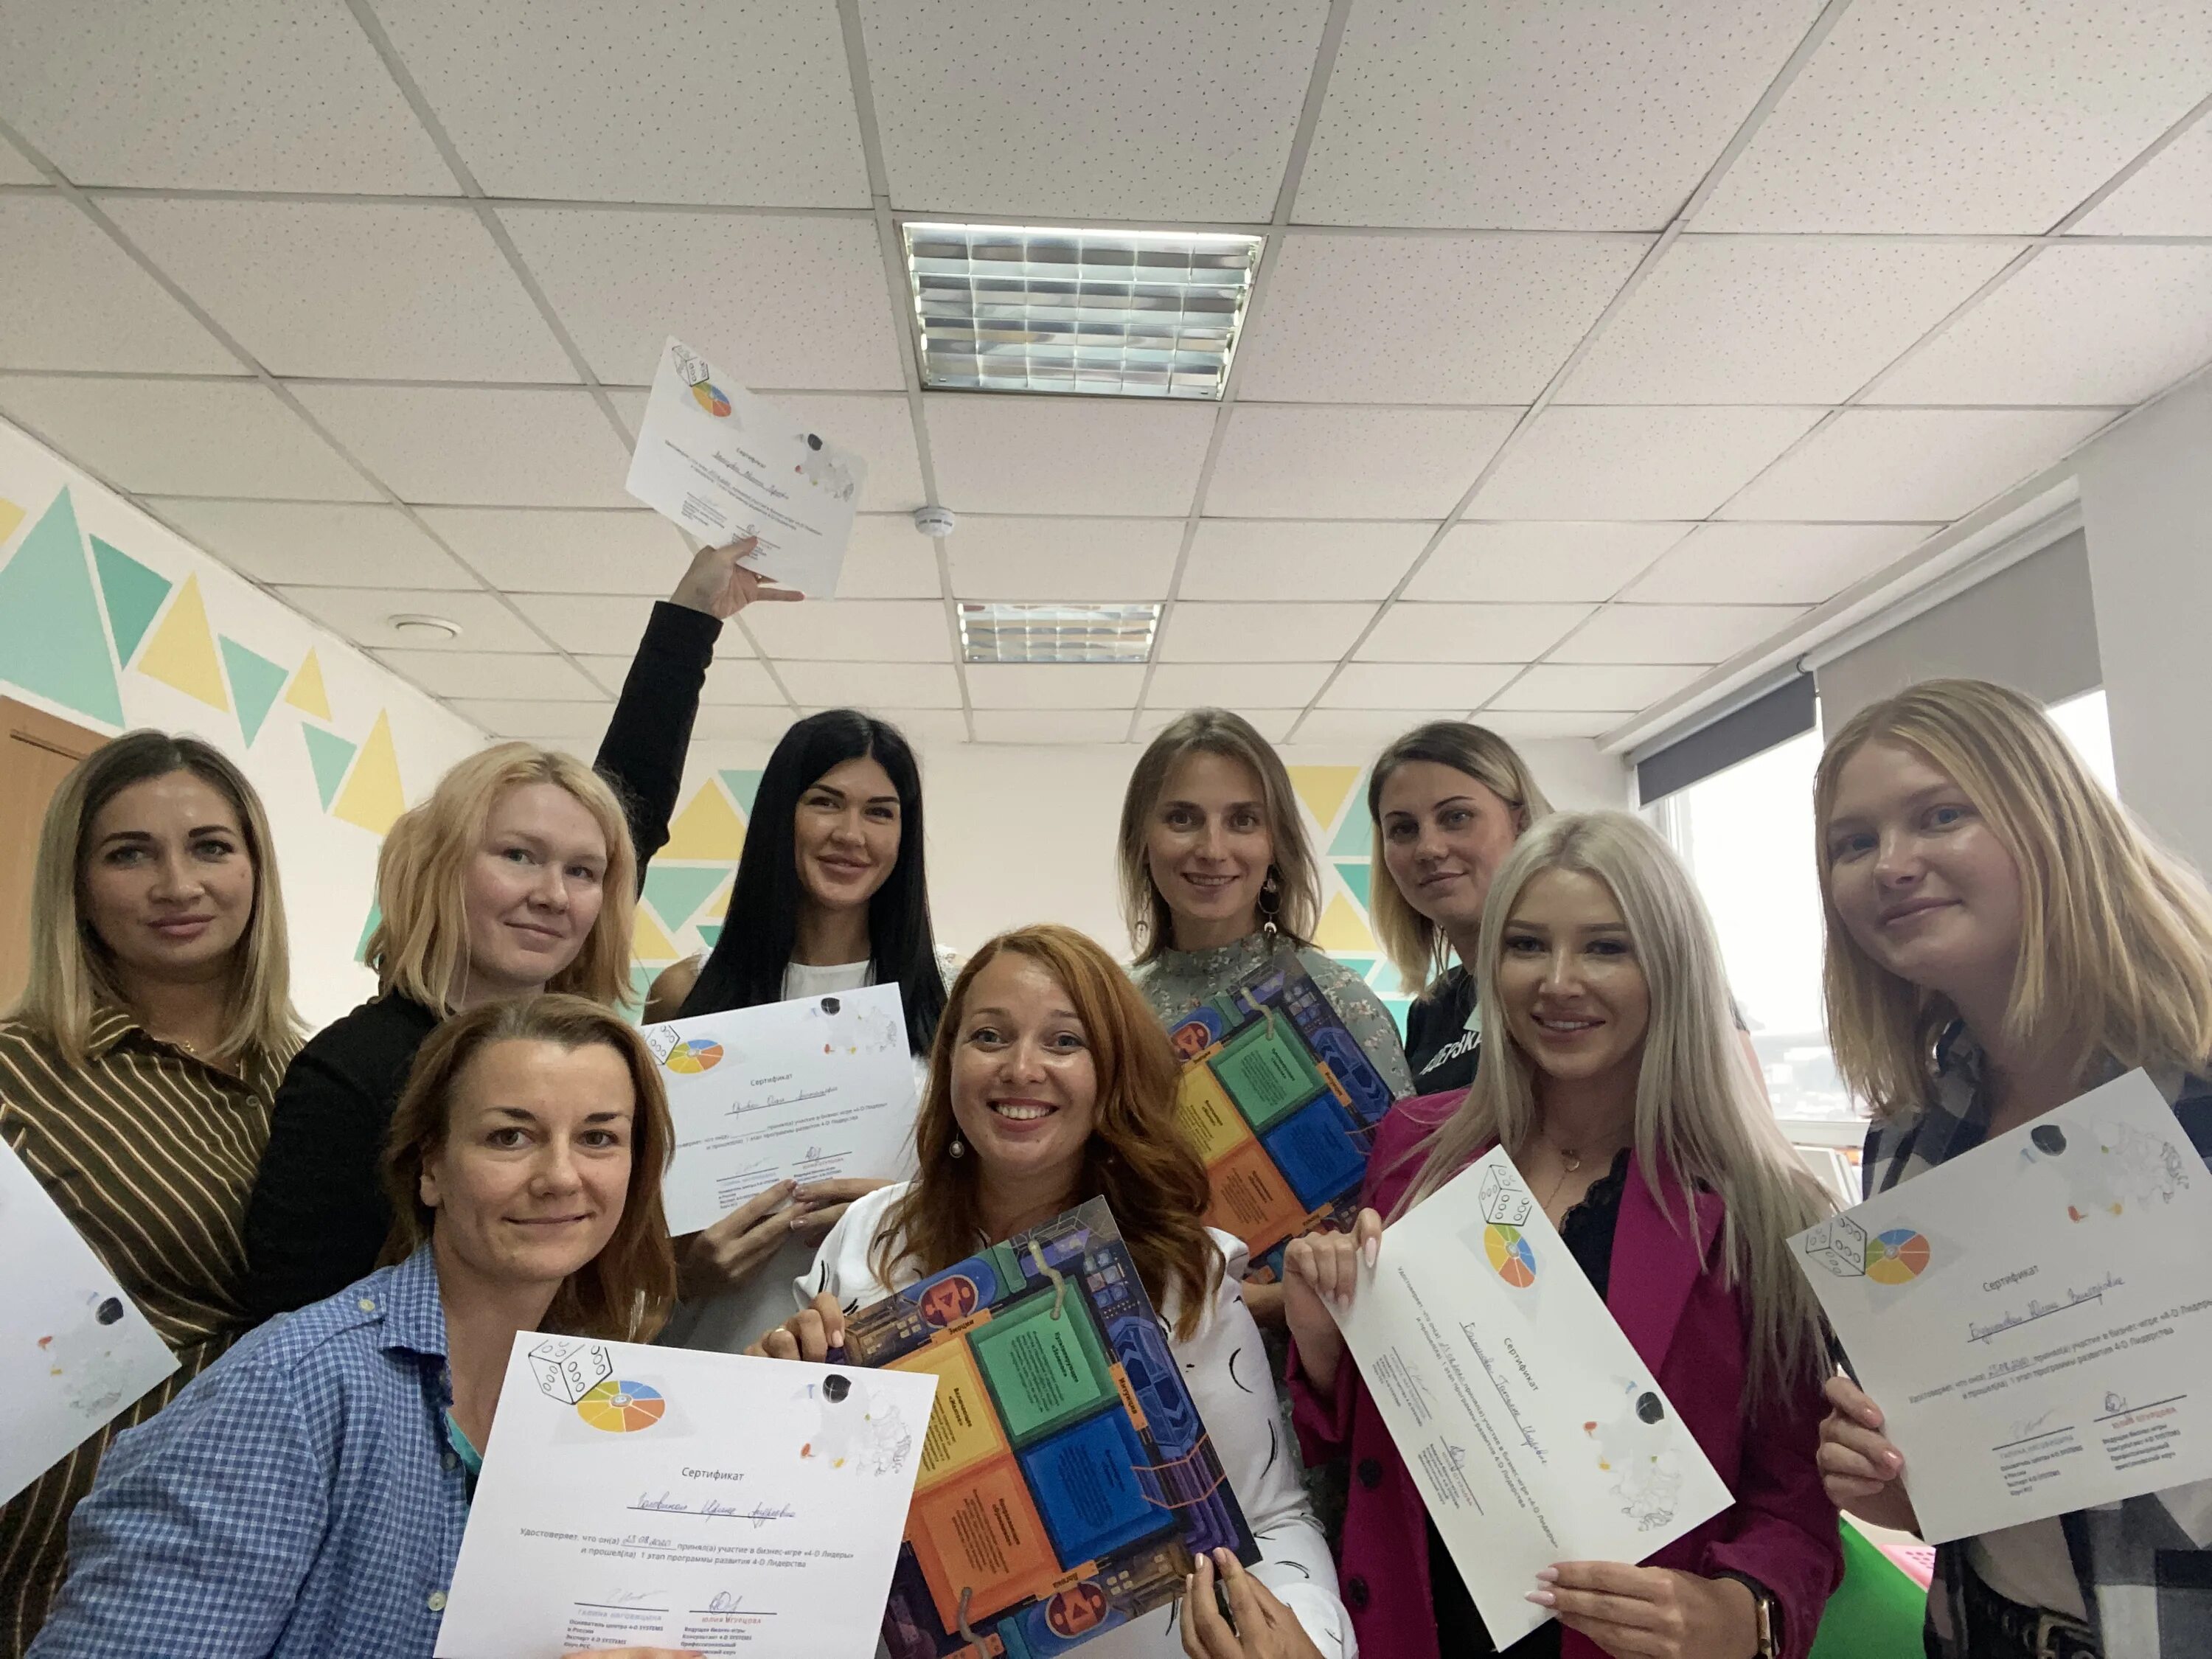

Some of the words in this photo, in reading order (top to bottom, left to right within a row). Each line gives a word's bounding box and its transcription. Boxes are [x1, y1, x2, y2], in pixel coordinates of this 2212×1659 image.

[751, 1073, 793, 1086] Сертификат
[1982, 1265, 2039, 1293] Сертификат
[1503, 1338, 1539, 1391] Сертификат
[1119, 1377, 1137, 1415] Интуиция
[682, 1467, 745, 1481] Сертификат
[582, 1535, 597, 1543] что
[599, 1536, 620, 1545] он(а)
[677, 1543, 716, 1554] принял(а)
[718, 1546, 748, 1555] участие
[756, 1547, 802, 1557] бизнес-игре
[821, 1551, 854, 1559] Лидеры»
[588, 1548, 636, 1559] прошел(ла)
[647, 1552, 665, 1560] этап
[667, 1554, 713, 1563] программы
[714, 1557, 751, 1566] развития
[767, 1559, 807, 1568] Лидерства
